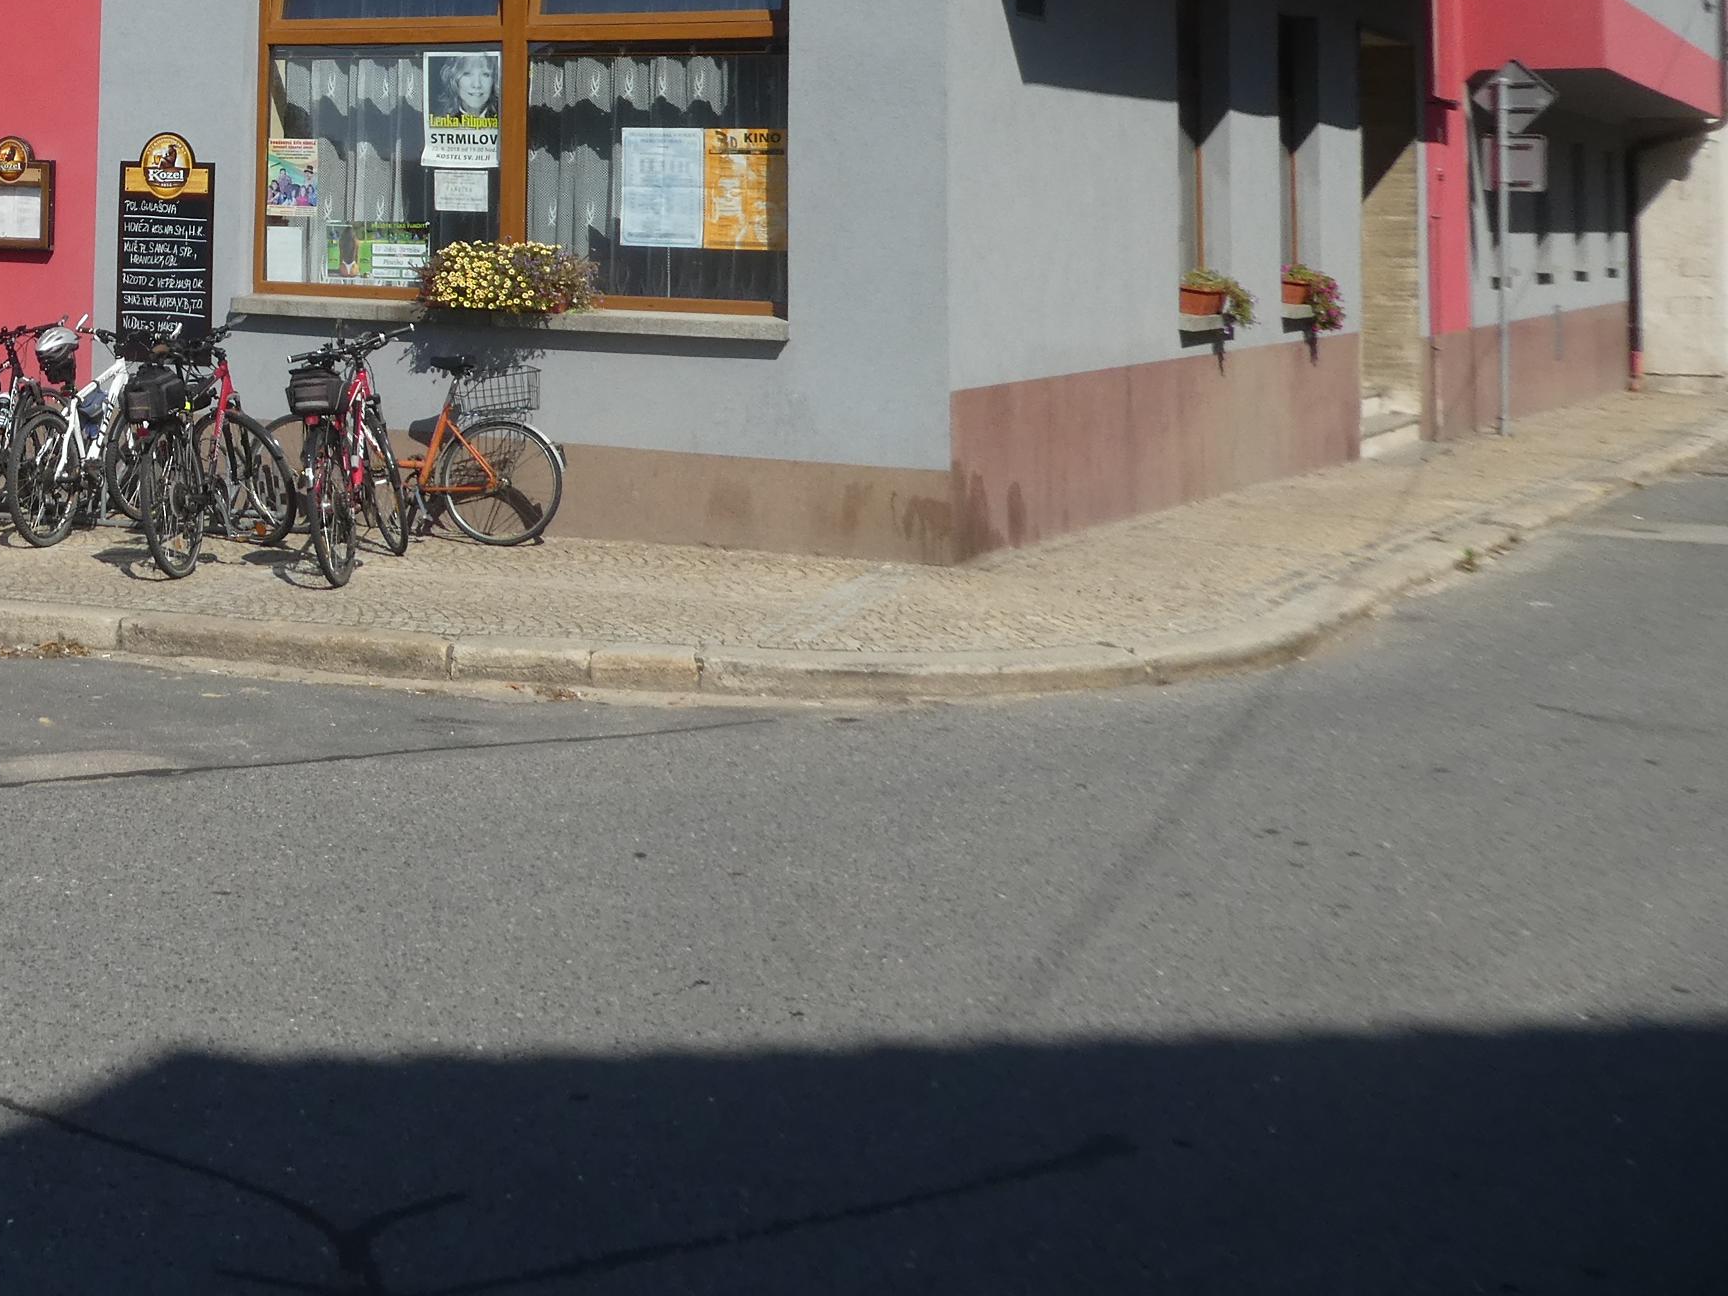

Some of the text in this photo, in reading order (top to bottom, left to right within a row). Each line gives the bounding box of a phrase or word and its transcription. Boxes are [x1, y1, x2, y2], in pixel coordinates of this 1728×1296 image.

[430, 114, 498, 130] Lenka Filipová
[430, 133, 498, 145] STRMILOV
[743, 132, 782, 144] KINO
[148, 168, 184, 182] Kozel
